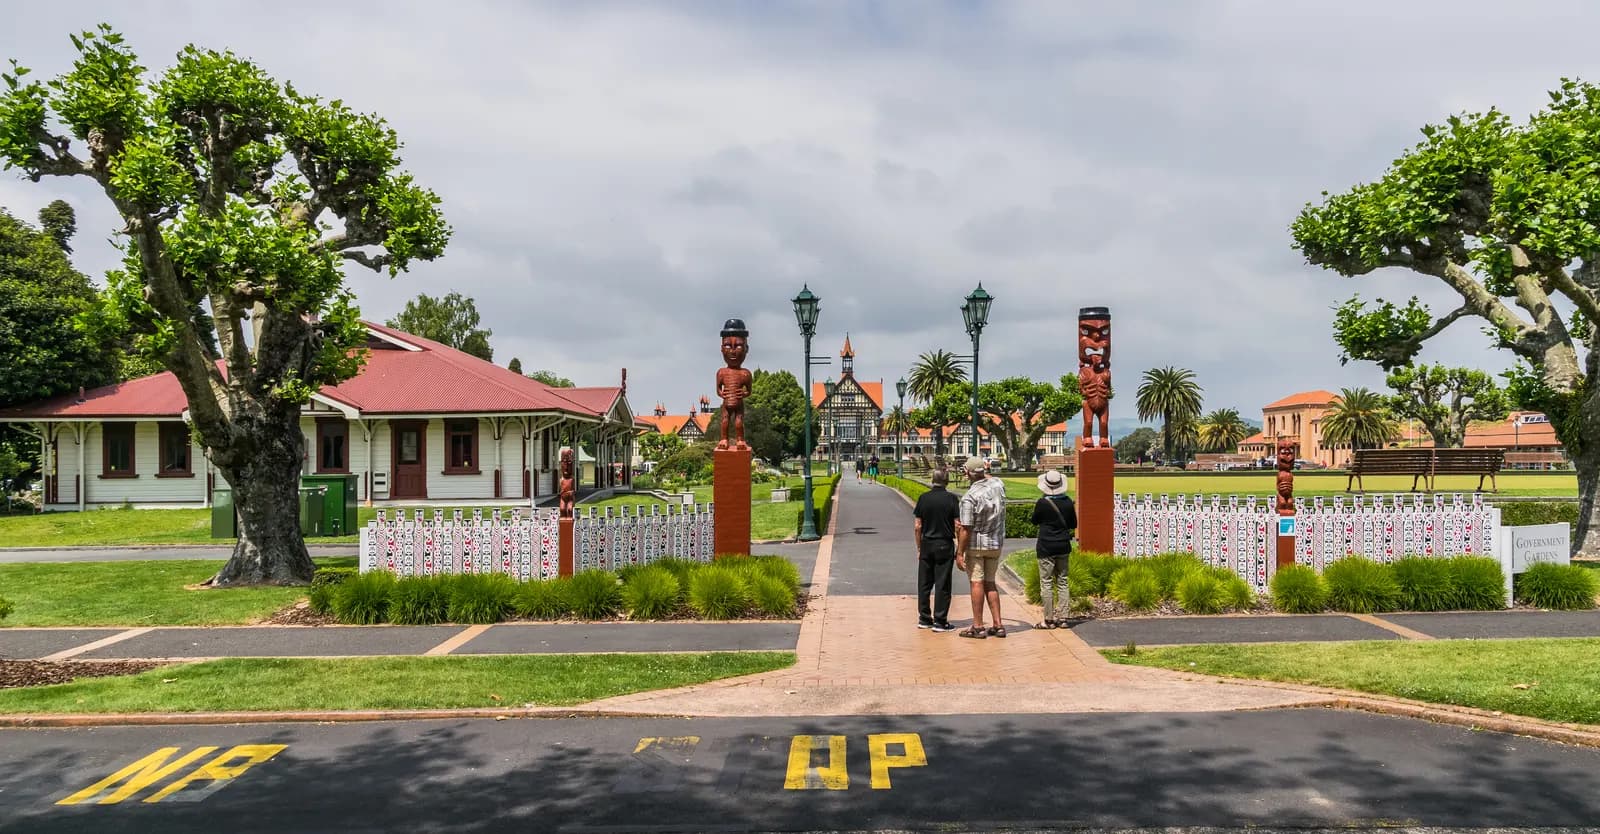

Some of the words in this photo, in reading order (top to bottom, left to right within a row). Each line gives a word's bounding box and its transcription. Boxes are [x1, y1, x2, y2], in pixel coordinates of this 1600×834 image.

[1516, 537, 1565, 549] GOVERNMENT
[1524, 550, 1558, 562] GARDENS
[54, 744, 289, 804] NP
